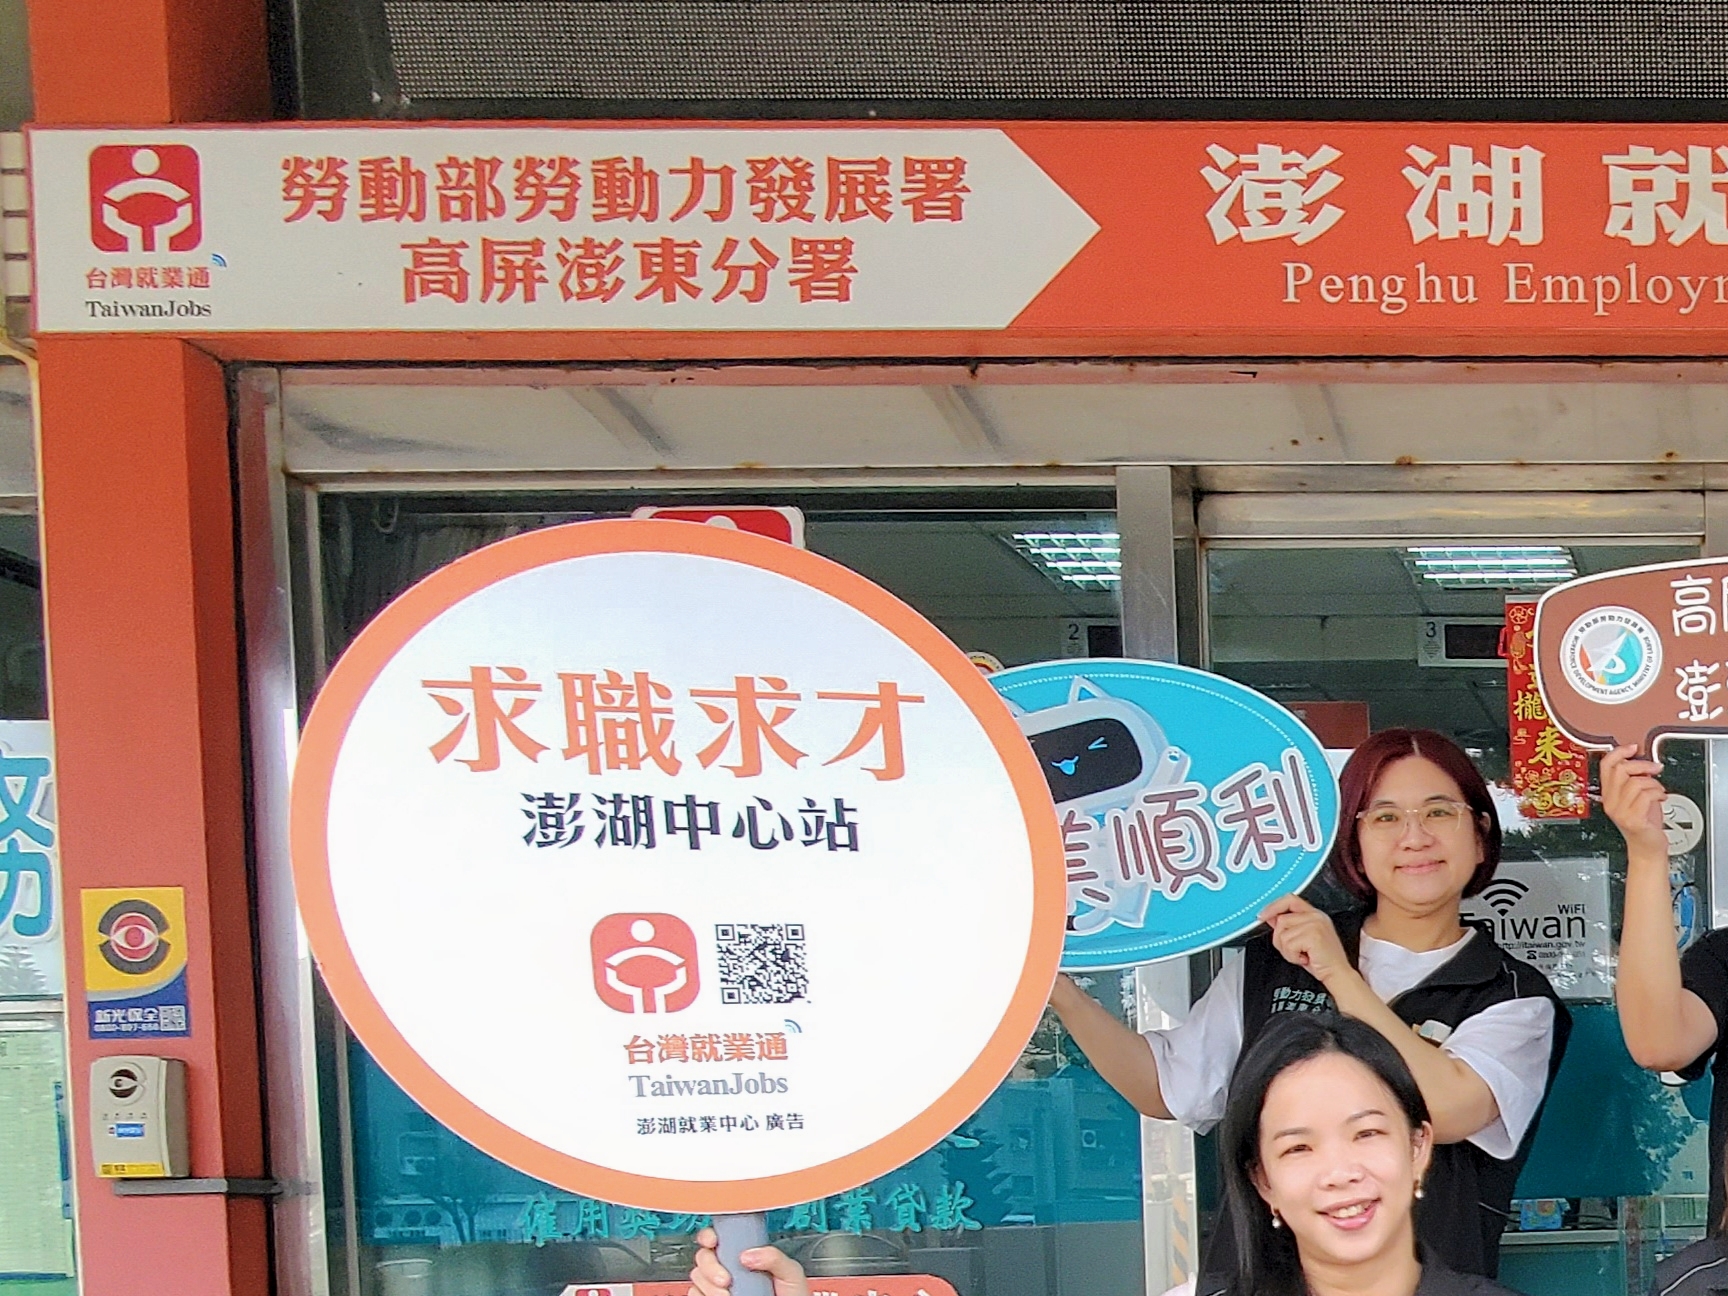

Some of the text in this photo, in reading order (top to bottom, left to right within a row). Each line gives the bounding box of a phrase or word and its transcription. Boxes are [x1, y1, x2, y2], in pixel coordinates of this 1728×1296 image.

[281, 155, 972, 226] 勞動部勞動力發展署
[86, 267, 210, 289] 台灣就業通
[402, 237, 860, 306] 高屏澎東分署
[1282, 262, 1478, 316] Penghu
[85, 299, 212, 318] TaiwanJobs
[1068, 623, 1080, 640] 2
[1425, 621, 1437, 638] 3
[421, 665, 925, 781] 求職求才
[520, 791, 860, 853] 澎湖中心站
[1558, 903, 1586, 914] WiFi
[623, 1032, 789, 1064] 台灣就業通
[628, 1072, 789, 1098] TaiwanJobs
[636, 1113, 804, 1135] 澎湖就業中心 廣告
